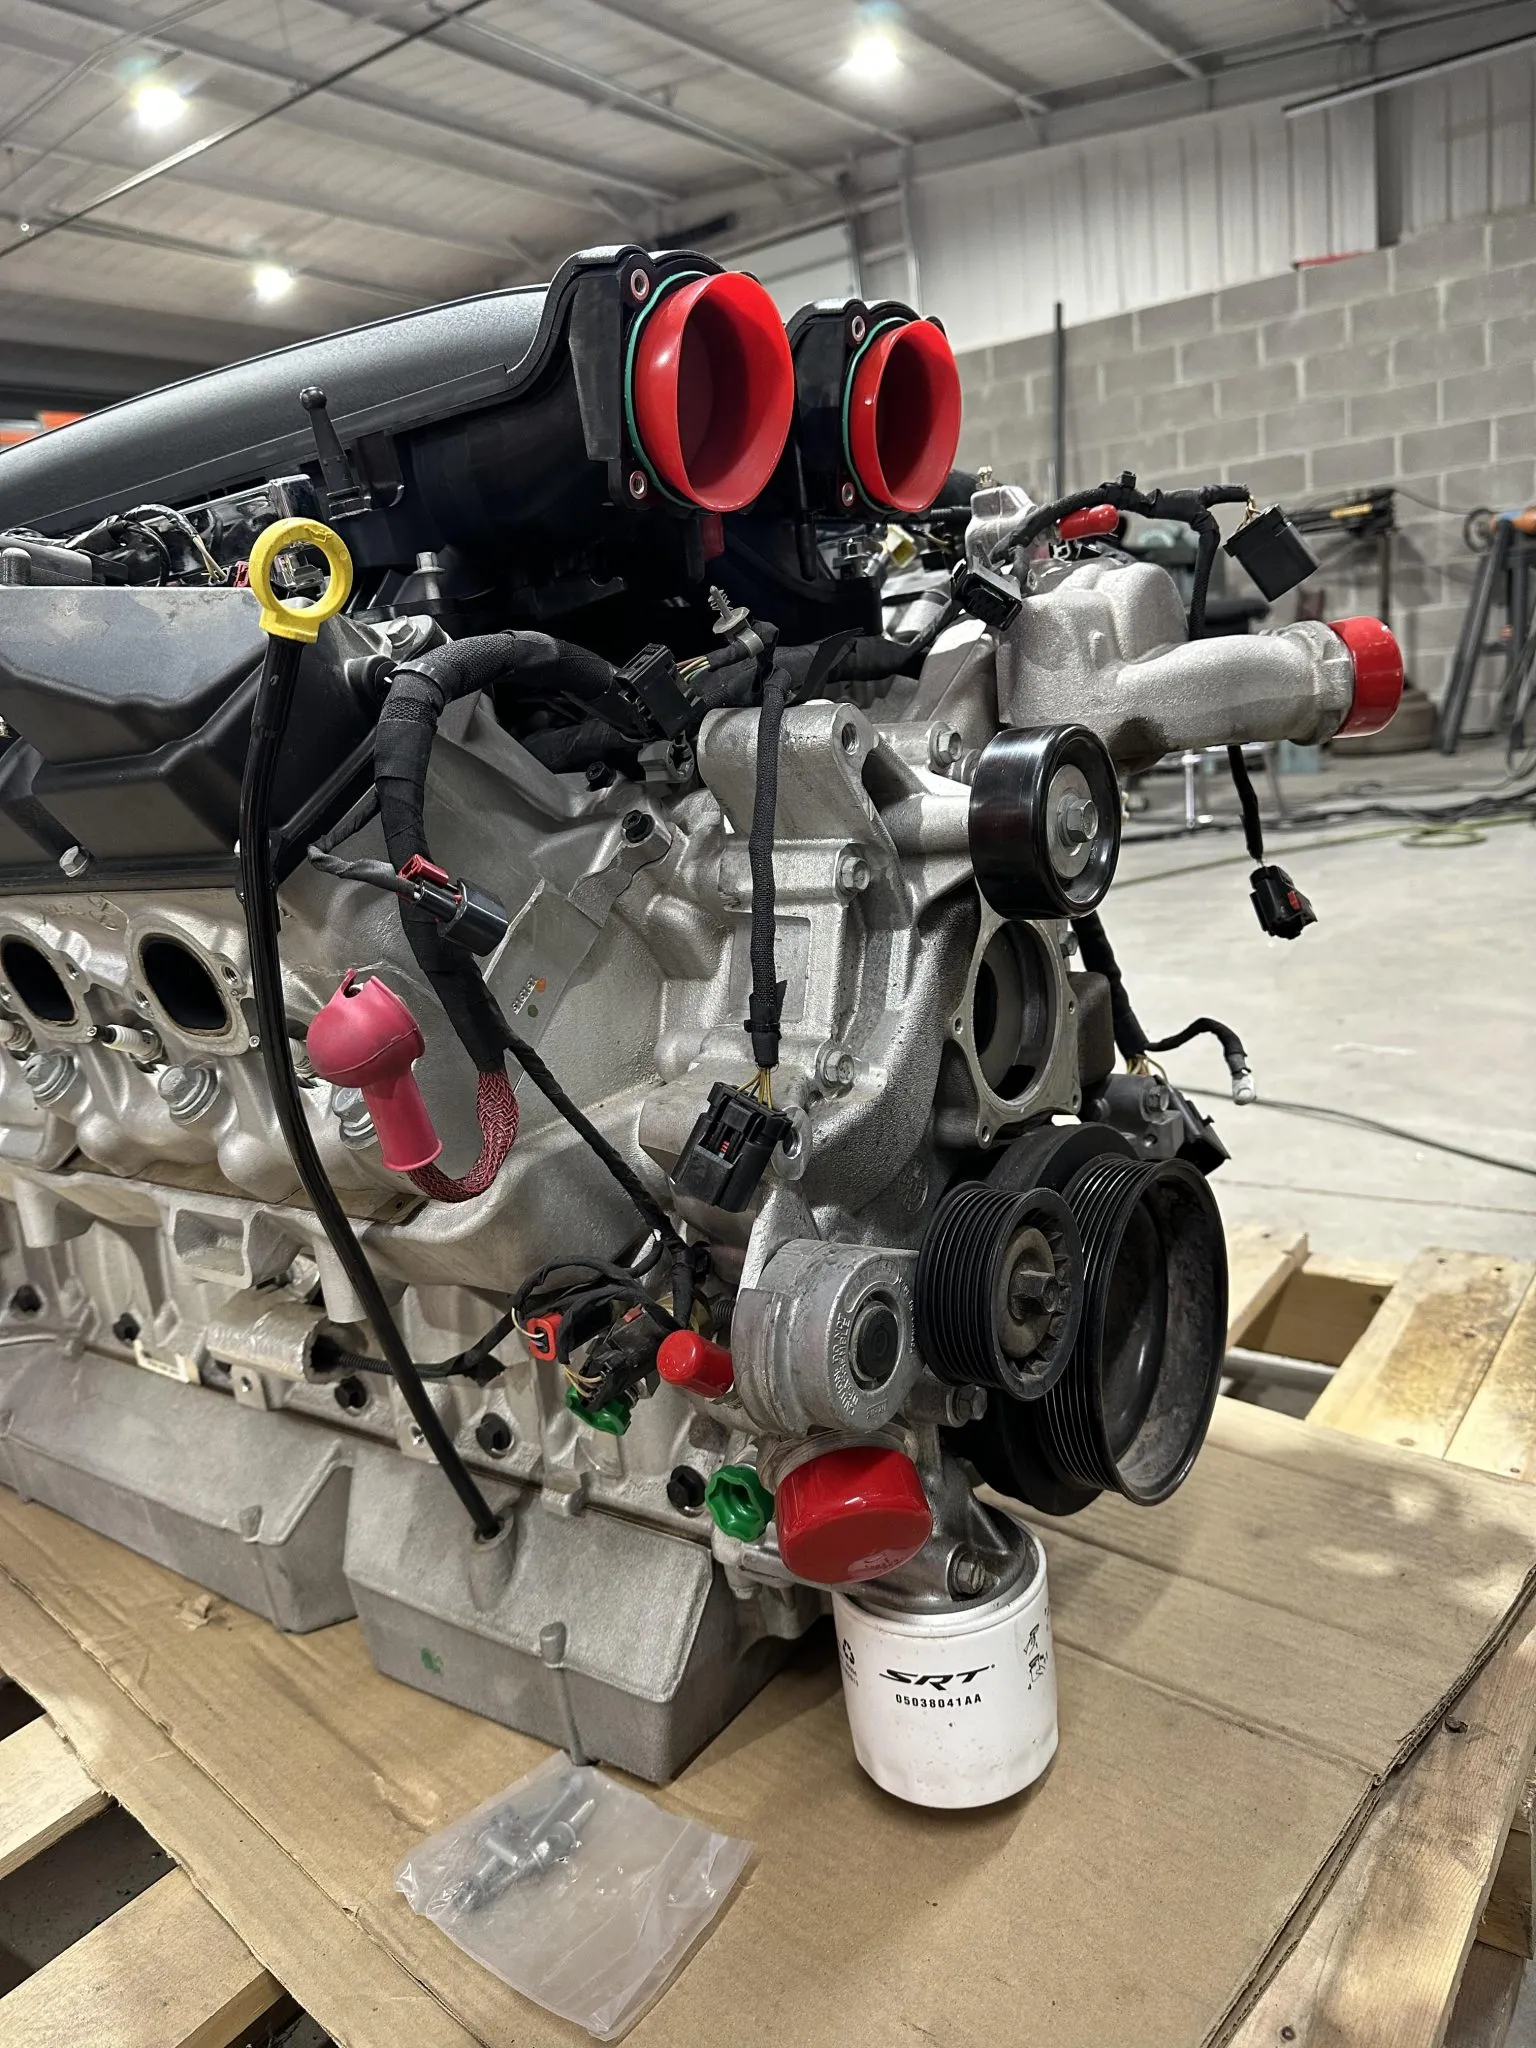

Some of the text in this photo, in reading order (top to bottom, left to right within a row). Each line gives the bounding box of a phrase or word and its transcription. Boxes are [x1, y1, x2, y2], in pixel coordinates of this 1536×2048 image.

[833, 1312, 845, 1339] NOT
[879, 1665, 990, 1691] SRT
[895, 1693, 982, 1708] 05038041AA
